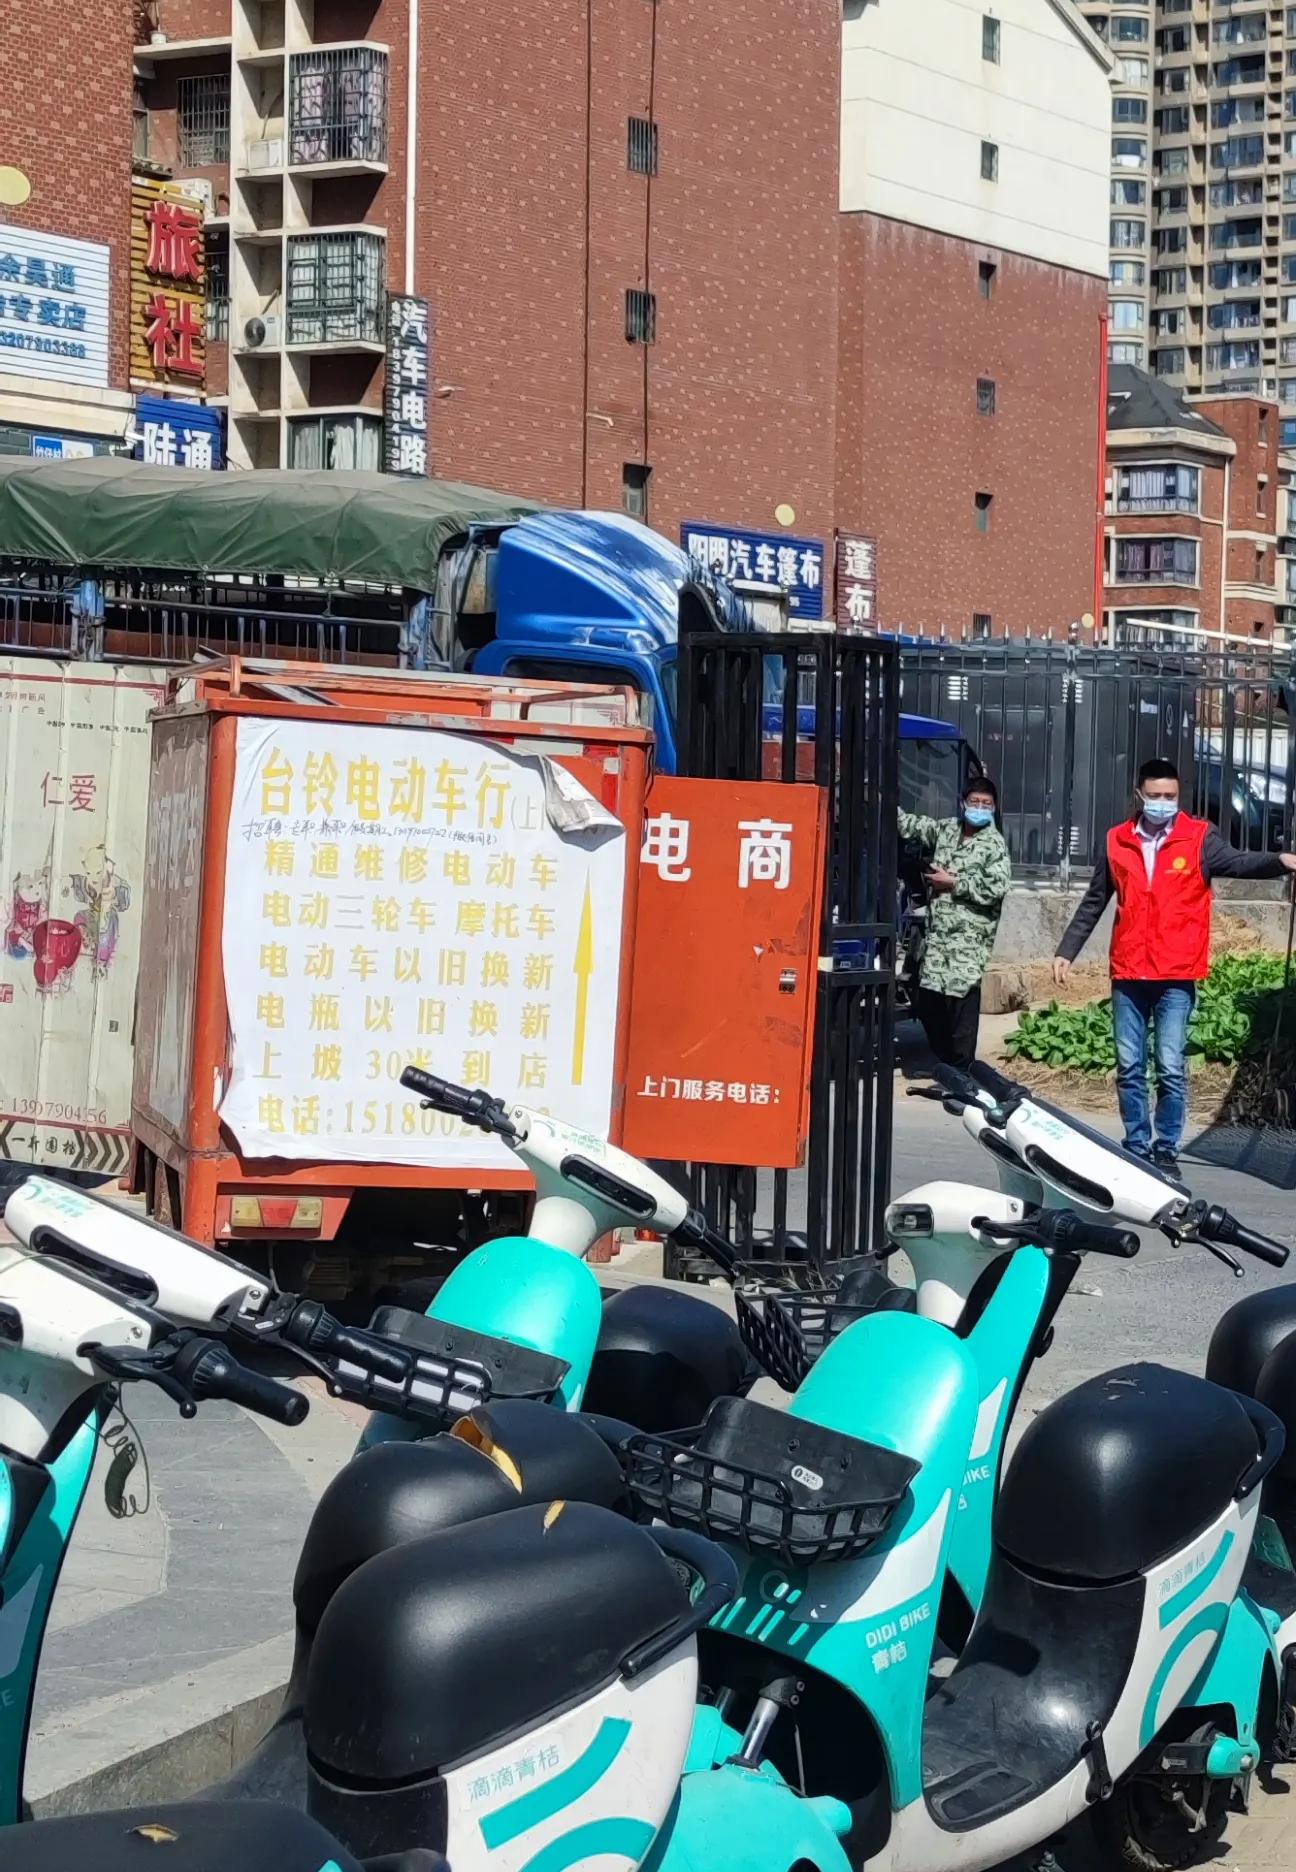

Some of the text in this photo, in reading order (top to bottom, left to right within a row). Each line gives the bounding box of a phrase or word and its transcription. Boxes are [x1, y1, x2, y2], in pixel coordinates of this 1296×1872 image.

[145, 202, 207, 377] 旅社
[401, 299, 428, 474] 汽车电路
[41, 771, 97, 813] 仁爱
[261, 747, 511, 830] 台铃电动车行
[263, 839, 559, 891] 精通维修电动车
[640, 812, 793, 890] 电商
[262, 890, 556, 940] 电动三轮车 摩托车
[259, 941, 555, 992] 电动车以旧换新
[256, 991, 551, 1041] 电瓶以旧换新
[637, 1076, 780, 1105] 上门服务电话:
[865, 1601, 932, 1649] DIDI BIKE
